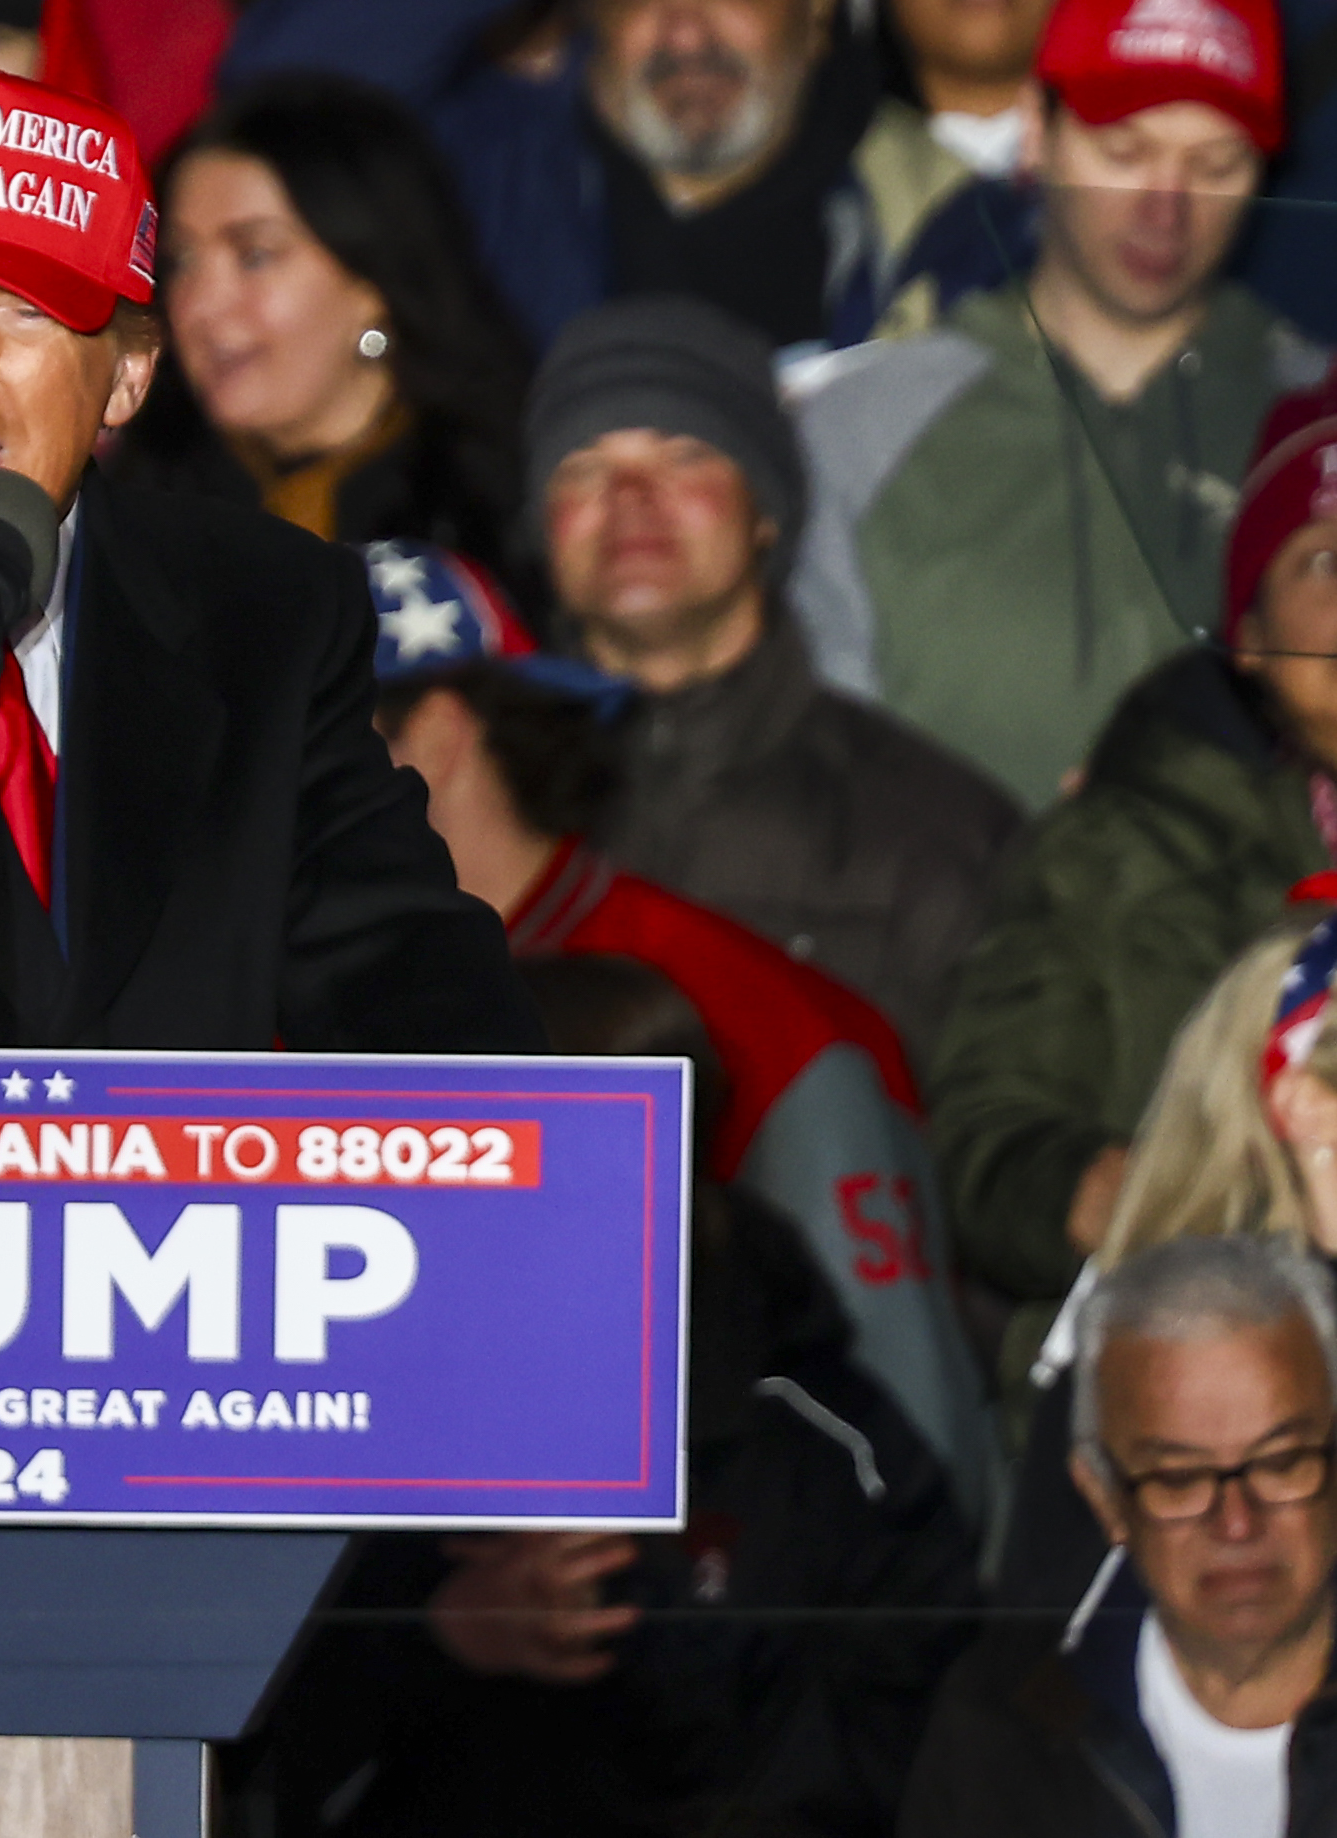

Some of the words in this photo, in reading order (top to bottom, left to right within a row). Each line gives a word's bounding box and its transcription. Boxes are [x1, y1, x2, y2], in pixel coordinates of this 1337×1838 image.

[183, 1123, 280, 1180] TO
[295, 1124, 515, 1184] 88022
[180, 1389, 371, 1432] AGAIN!
